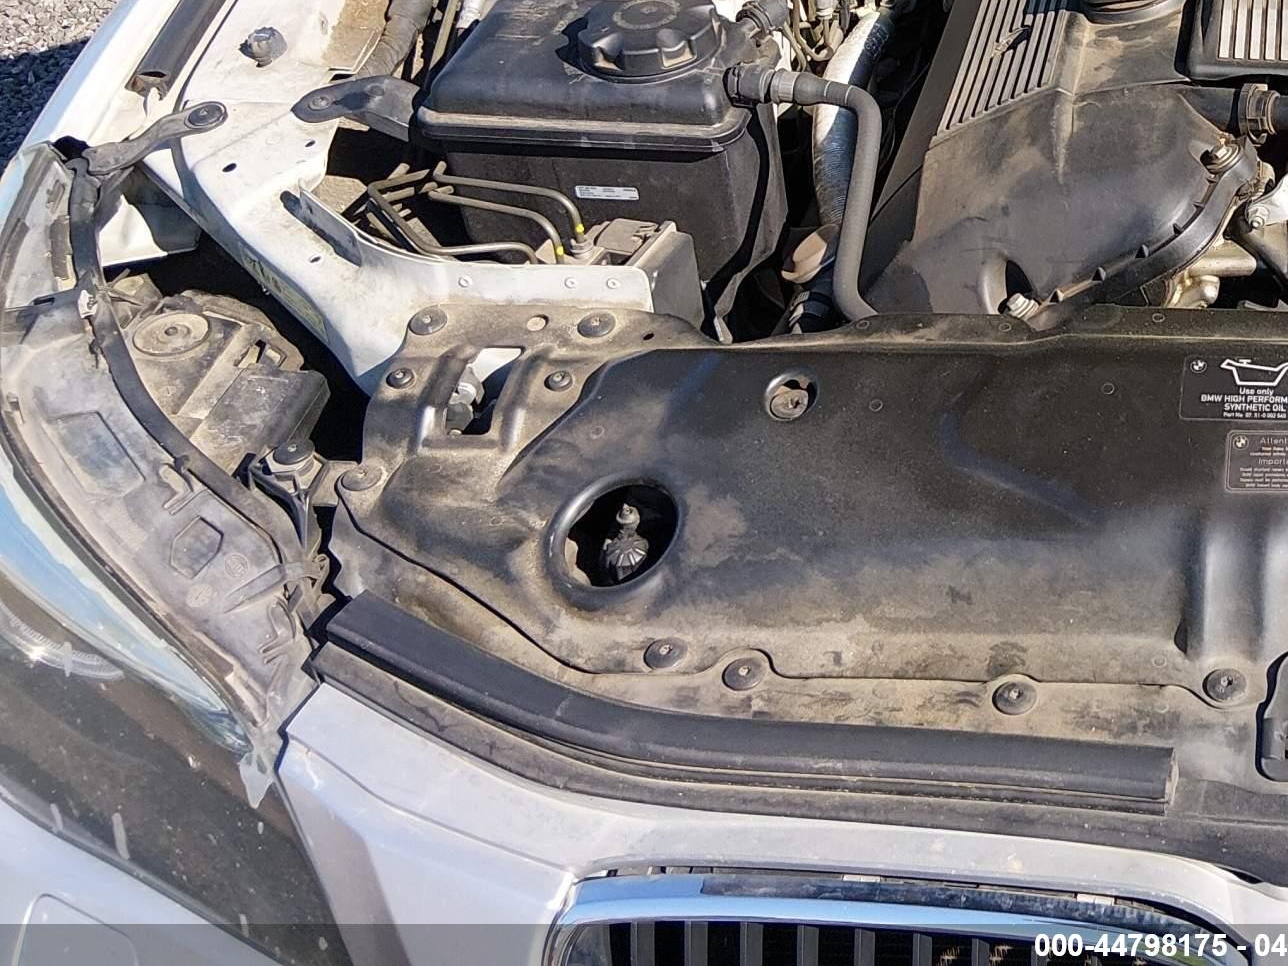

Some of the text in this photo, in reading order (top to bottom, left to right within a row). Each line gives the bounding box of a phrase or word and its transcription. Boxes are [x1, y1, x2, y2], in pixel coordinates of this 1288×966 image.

[1239, 387, 1274, 396] Use only
[1201, 394, 1222, 402] BMW
[1224, 395, 1246, 403] HIGH
[1224, 403, 1286, 412] SYNTHETIC OIL
